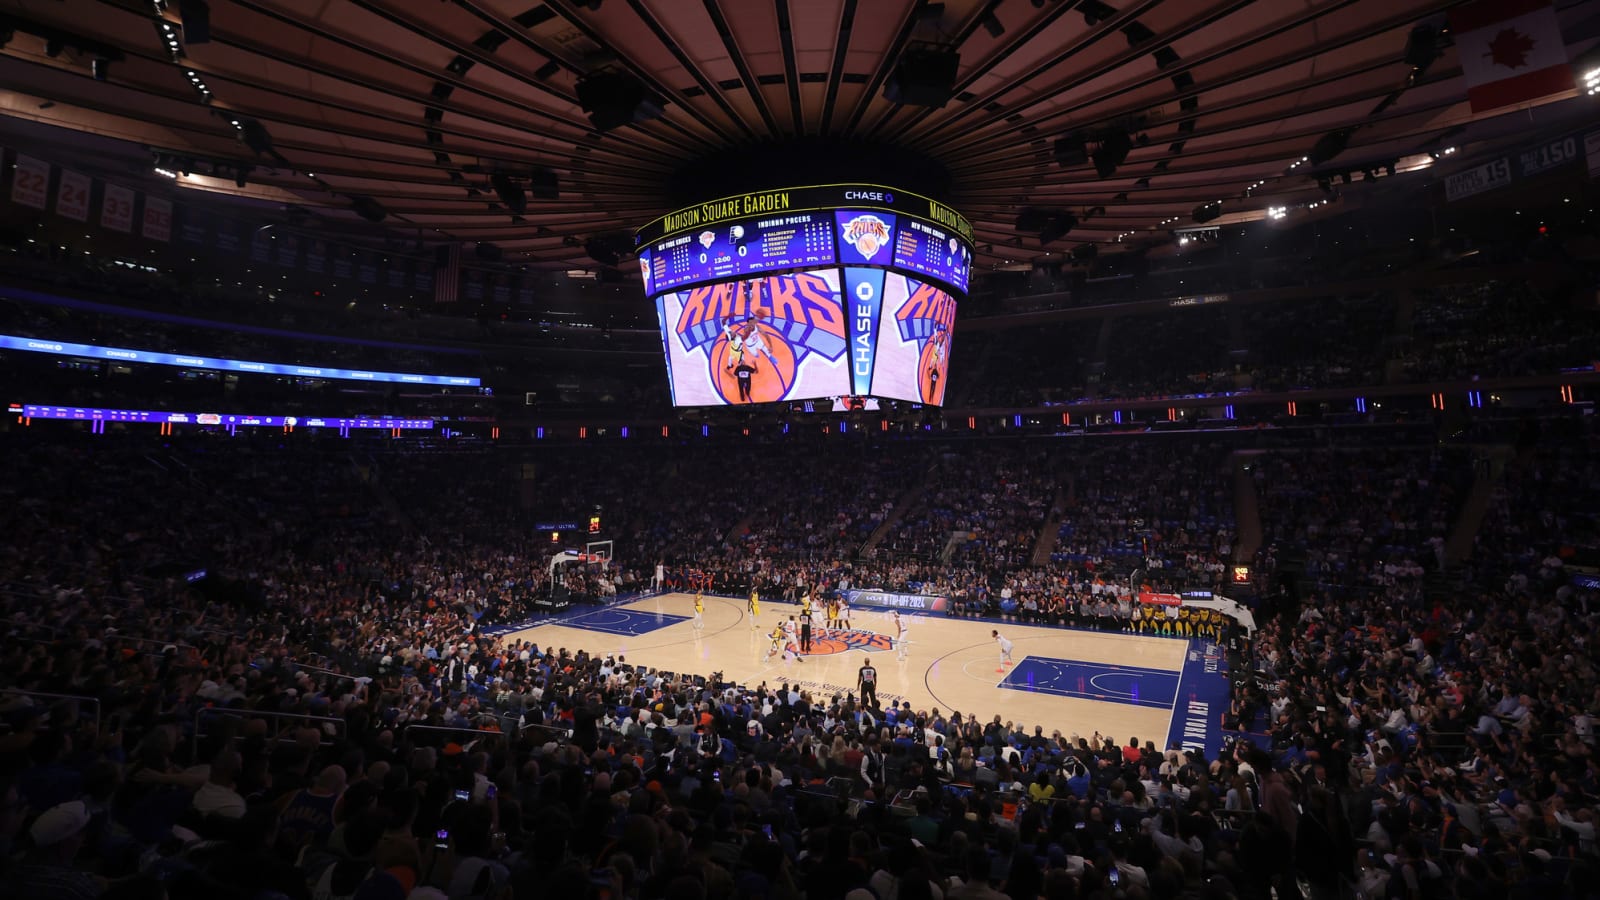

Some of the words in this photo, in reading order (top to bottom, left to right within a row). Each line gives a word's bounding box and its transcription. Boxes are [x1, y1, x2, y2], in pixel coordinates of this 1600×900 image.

[1541, 138, 1576, 166] 150
[16, 169, 44, 192] 22
[1487, 160, 1506, 182] 15
[62, 184, 86, 207] 24
[845, 191, 883, 201] CHASE
[106, 198, 130, 217] 33
[664, 208, 699, 233] MADISON
[702, 199, 740, 222] SQUARE
[744, 193, 789, 214] GARDEN
[785, 216, 811, 224] PACERS
[699, 253, 707, 264] 0
[714, 256, 731, 264] 12:00
[738, 246, 747, 257] 0
[855, 303, 872, 376] CHASE
[910, 597, 925, 608] 2024
[1188, 701, 1208, 716] NEW
[1184, 717, 1207, 739] YORK
